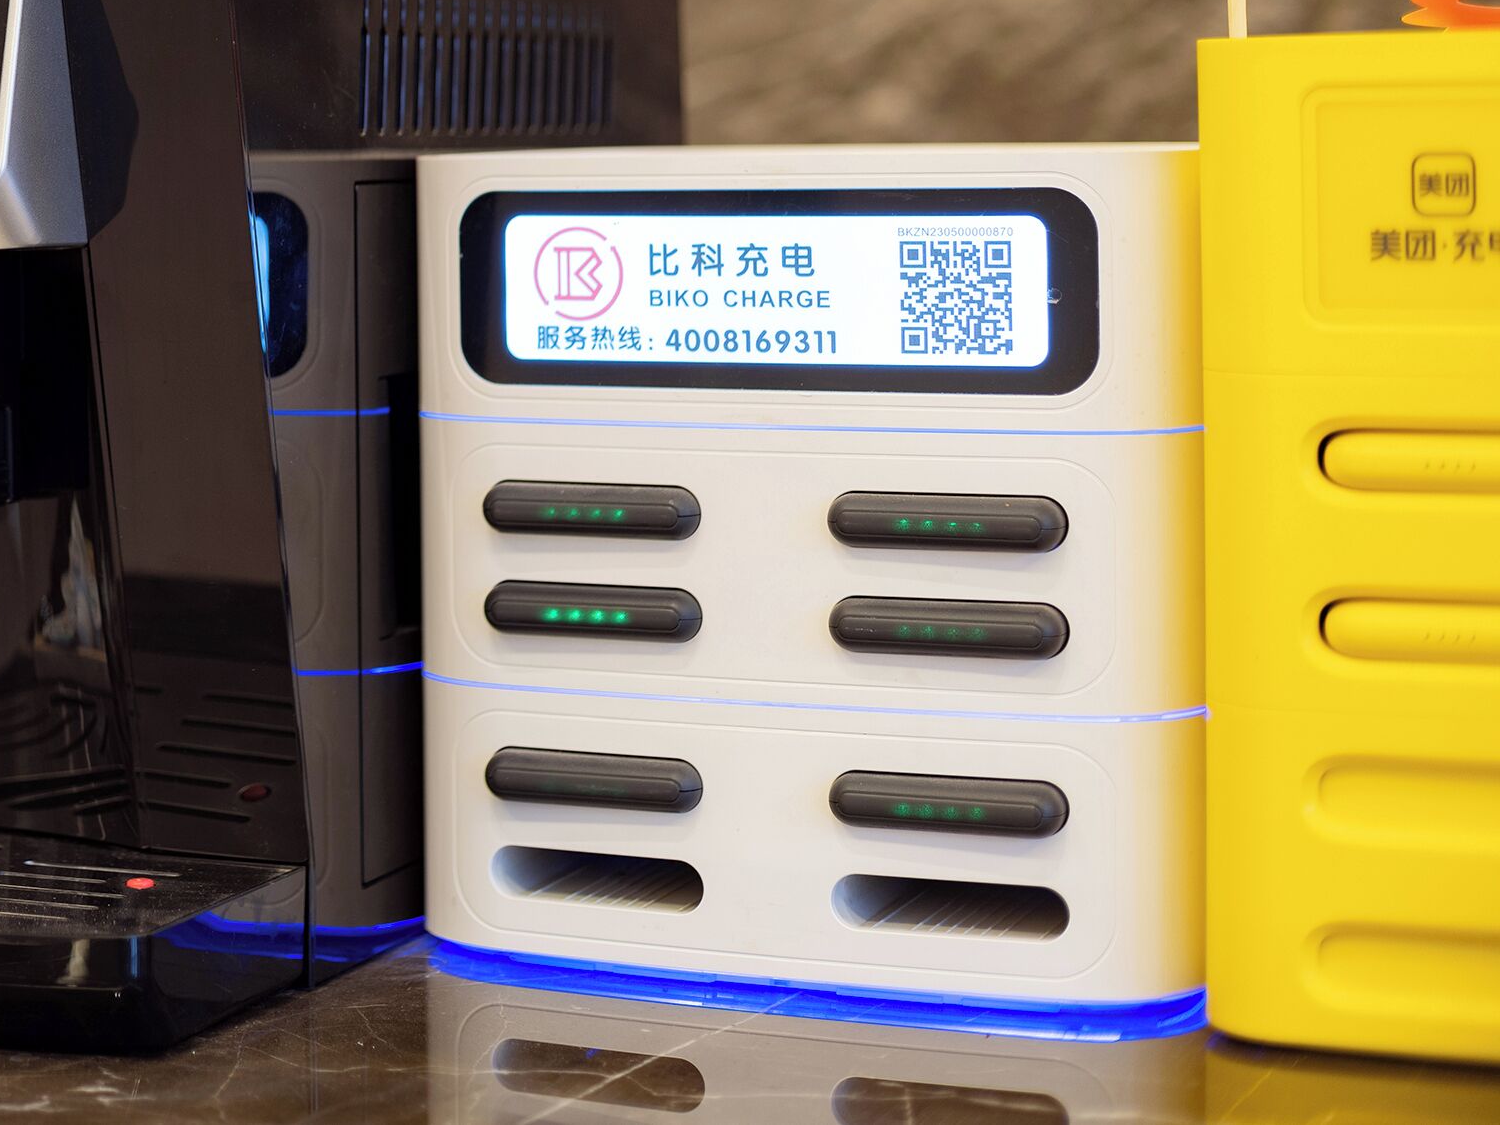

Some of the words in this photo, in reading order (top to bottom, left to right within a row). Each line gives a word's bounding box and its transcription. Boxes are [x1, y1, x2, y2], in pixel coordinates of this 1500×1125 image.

[1419, 173, 1470, 198] 美团
[897, 227, 1014, 237] BKZN230500000870
[649, 243, 815, 277] 比科充电
[649, 290, 709, 307] BIKO
[723, 290, 831, 309] CHARGE
